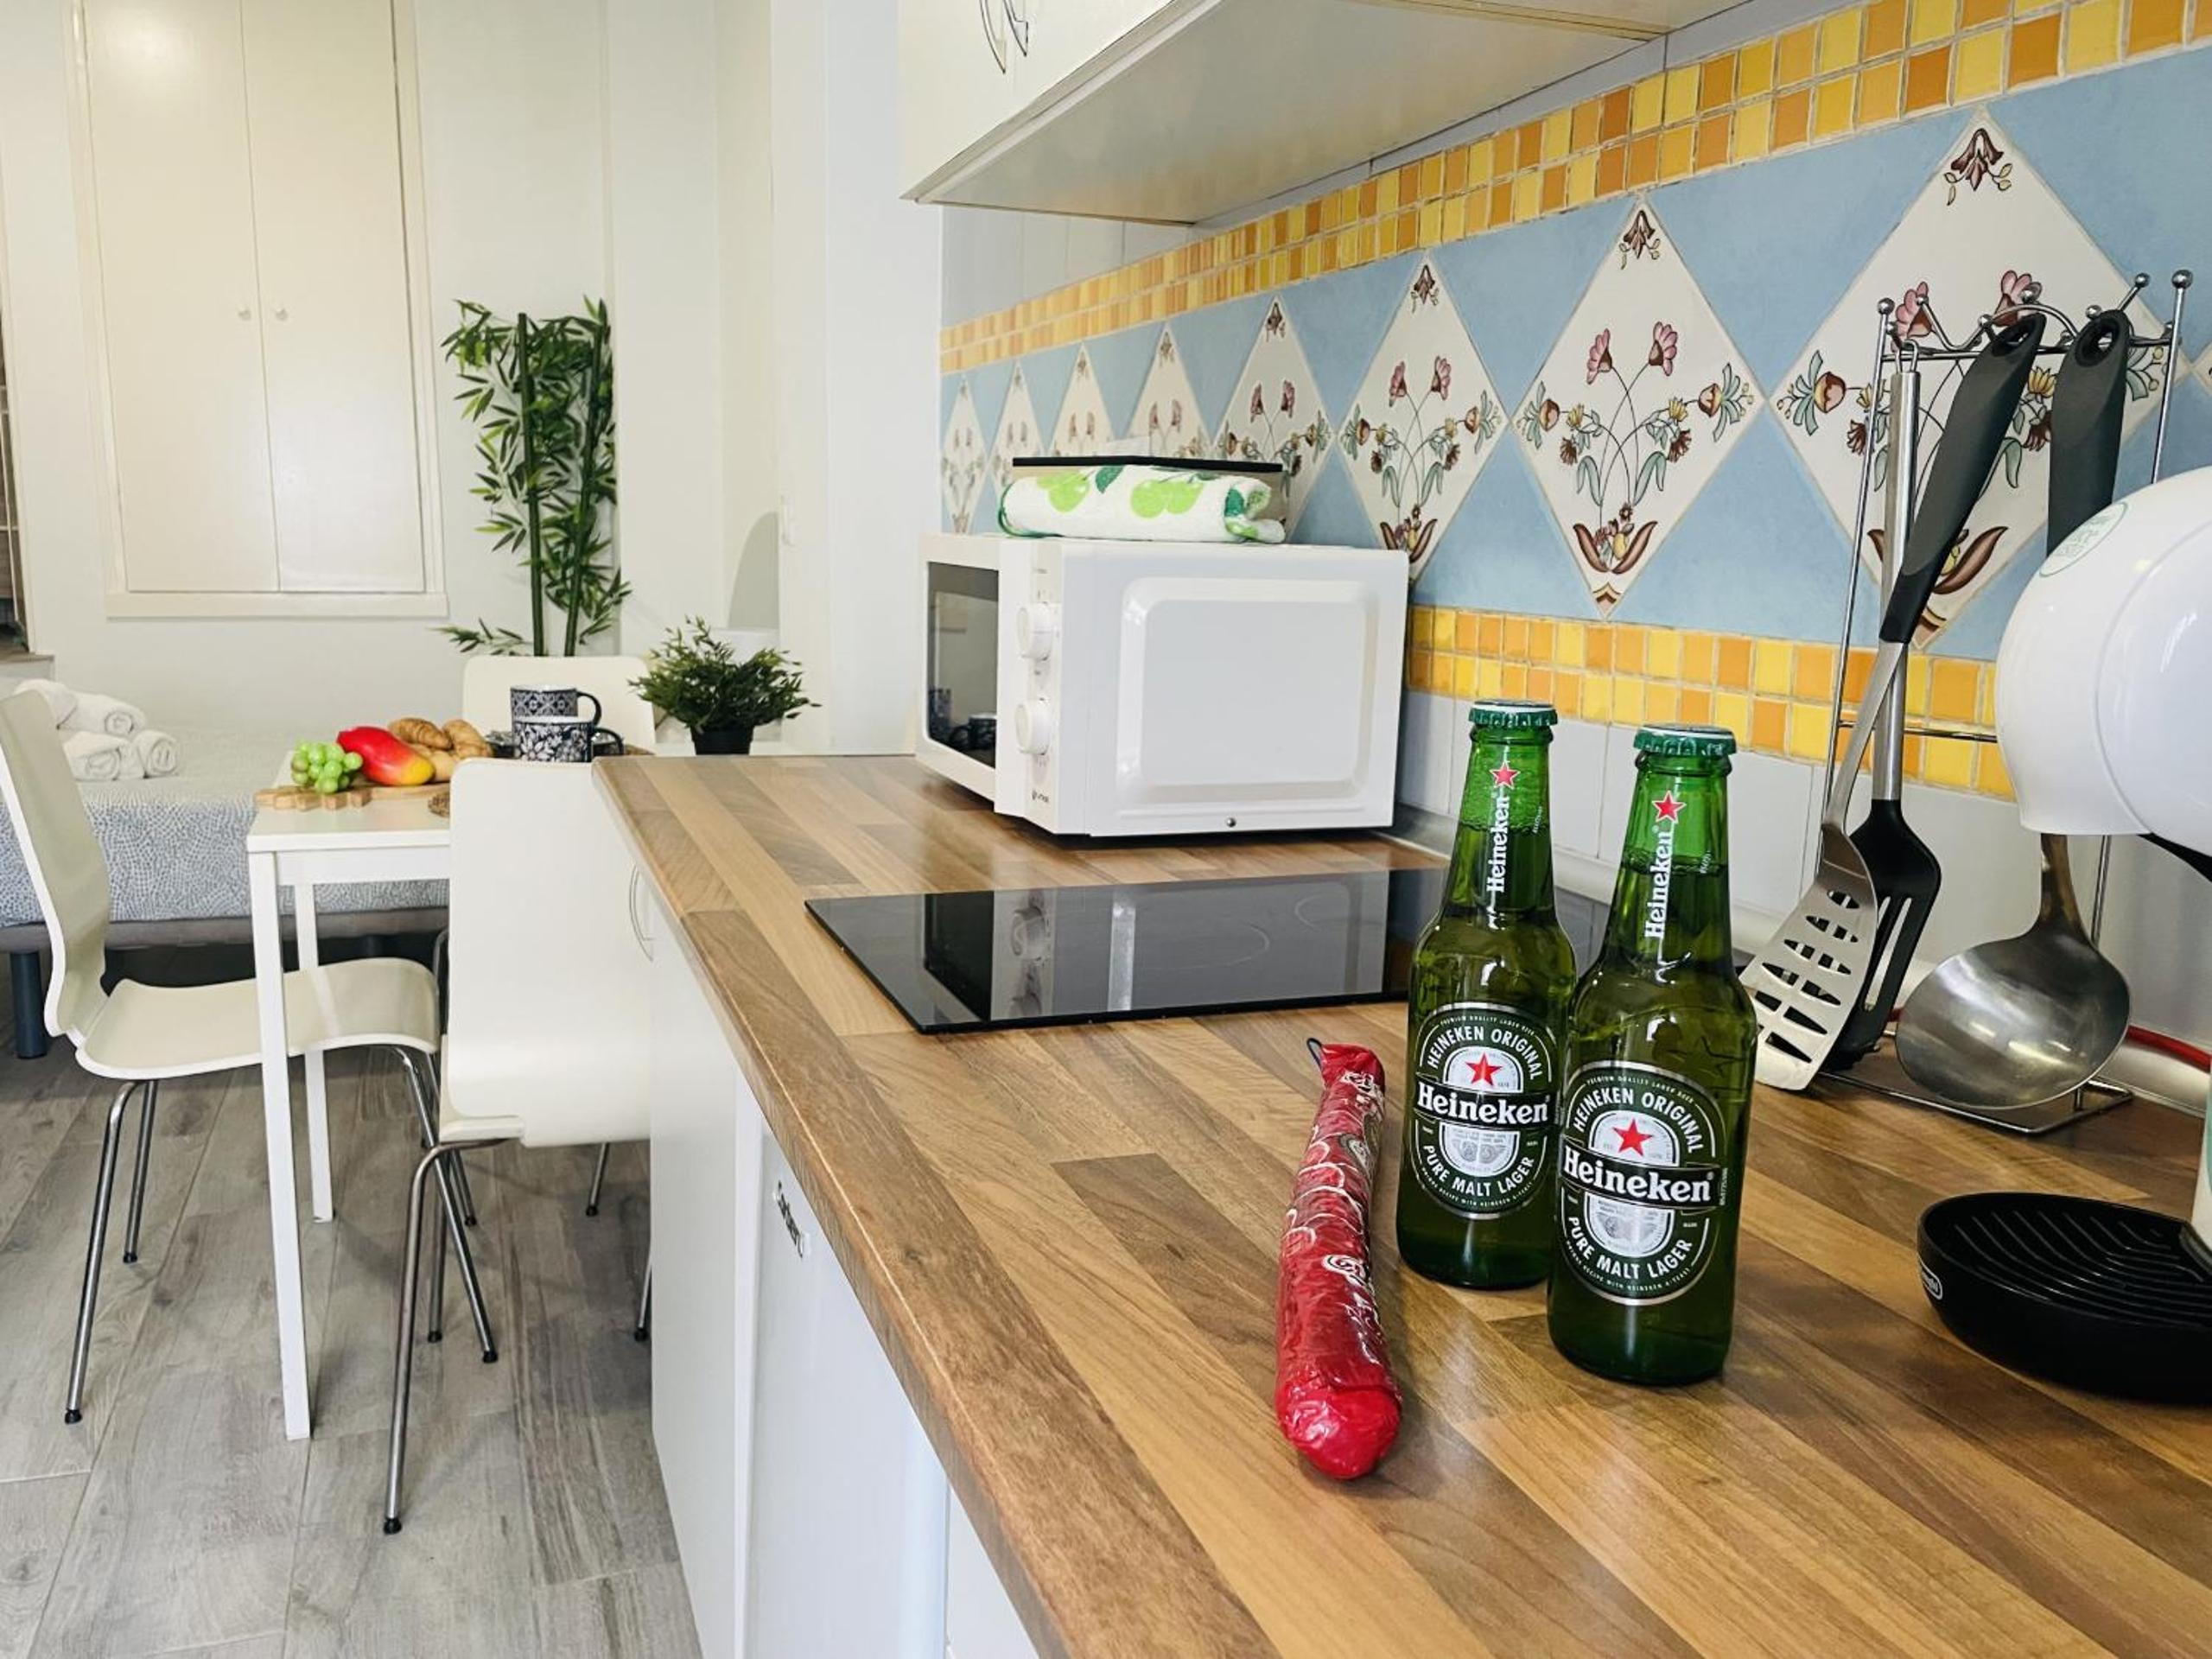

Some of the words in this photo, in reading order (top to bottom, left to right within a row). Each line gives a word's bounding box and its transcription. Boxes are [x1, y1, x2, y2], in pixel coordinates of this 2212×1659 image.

[1486, 795, 1510, 893] Heineken
[1644, 830, 1672, 939] Heineken
[1427, 1026, 1484, 1070] HEINEKEN
[1491, 1028, 1543, 1081] ORIGINAL
[1417, 1081, 1548, 1125] Heineken
[1573, 1087, 1635, 1134] HEINEKEN
[1641, 1091, 1705, 1154] ORIGINAL
[1422, 1145, 1451, 1183] PURE
[1451, 1176, 1492, 1198] MALT
[1497, 1156, 1535, 1195] LAGER
[1563, 1145, 1712, 1203] Heineken
[1567, 1217, 1595, 1261] PURE
[1596, 1254, 1641, 1280] MALT
[1646, 1239, 1694, 1279] LAGER
